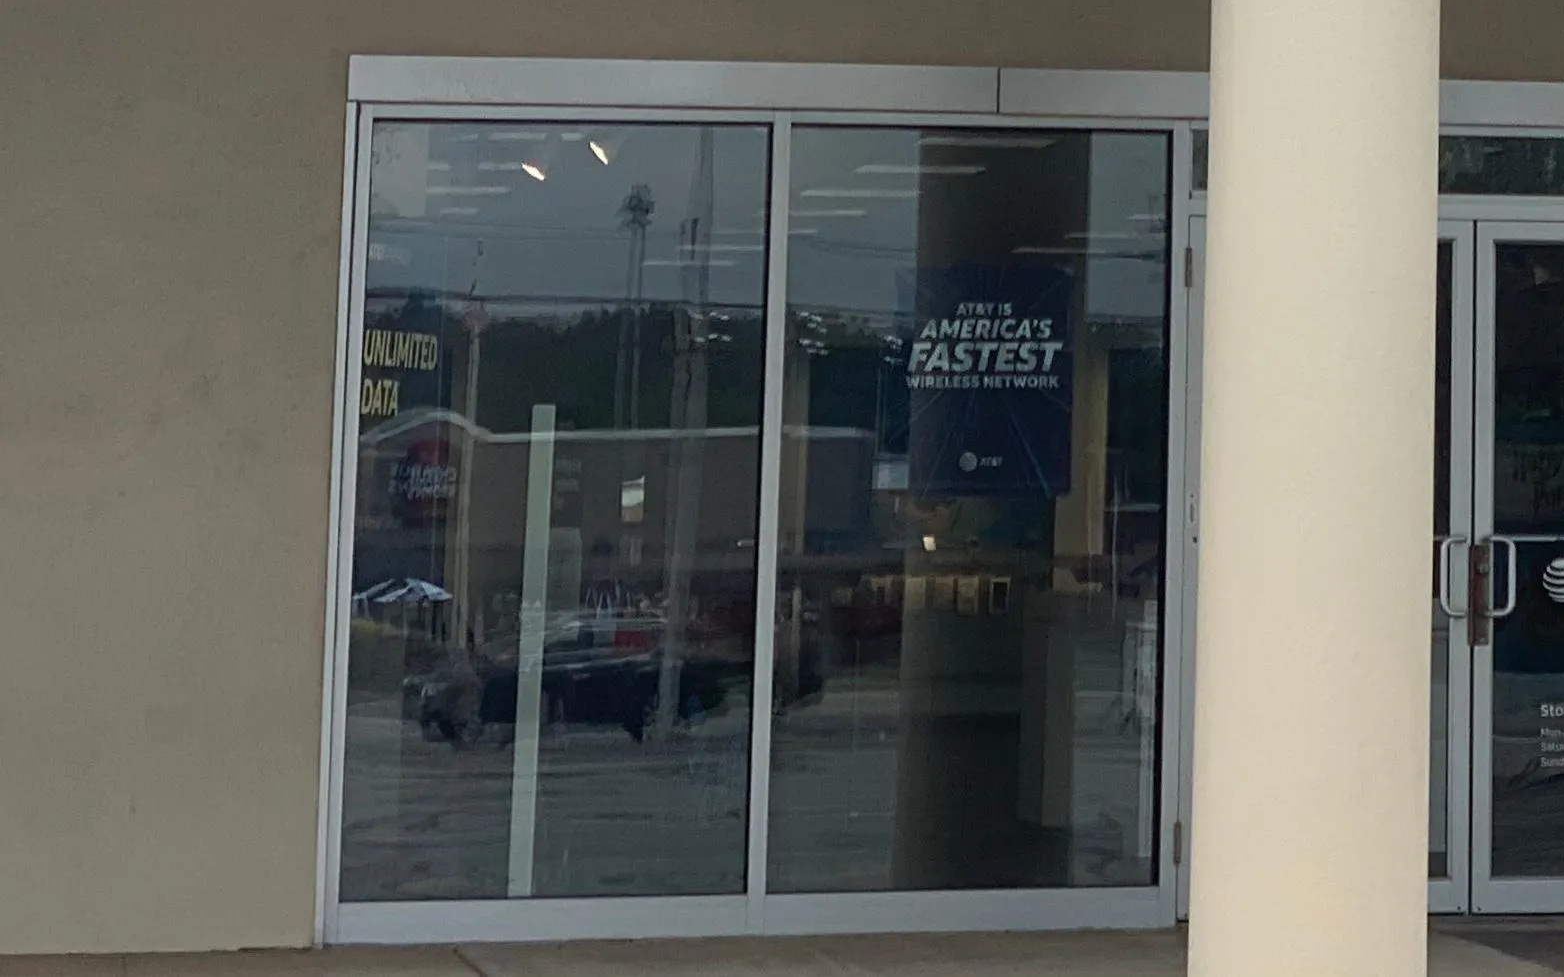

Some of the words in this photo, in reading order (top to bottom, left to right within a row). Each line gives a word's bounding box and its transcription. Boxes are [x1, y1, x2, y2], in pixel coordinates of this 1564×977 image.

[956, 302, 994, 316] AT&T
[998, 302, 1012, 316] IS
[920, 319, 1053, 339] AMERICA'S
[363, 329, 438, 370] UNLIMITED
[907, 342, 1063, 372] FASTEST
[906, 375, 980, 389] WIRELESS
[984, 375, 1059, 388] NETWORK
[361, 378, 399, 416] DATA
